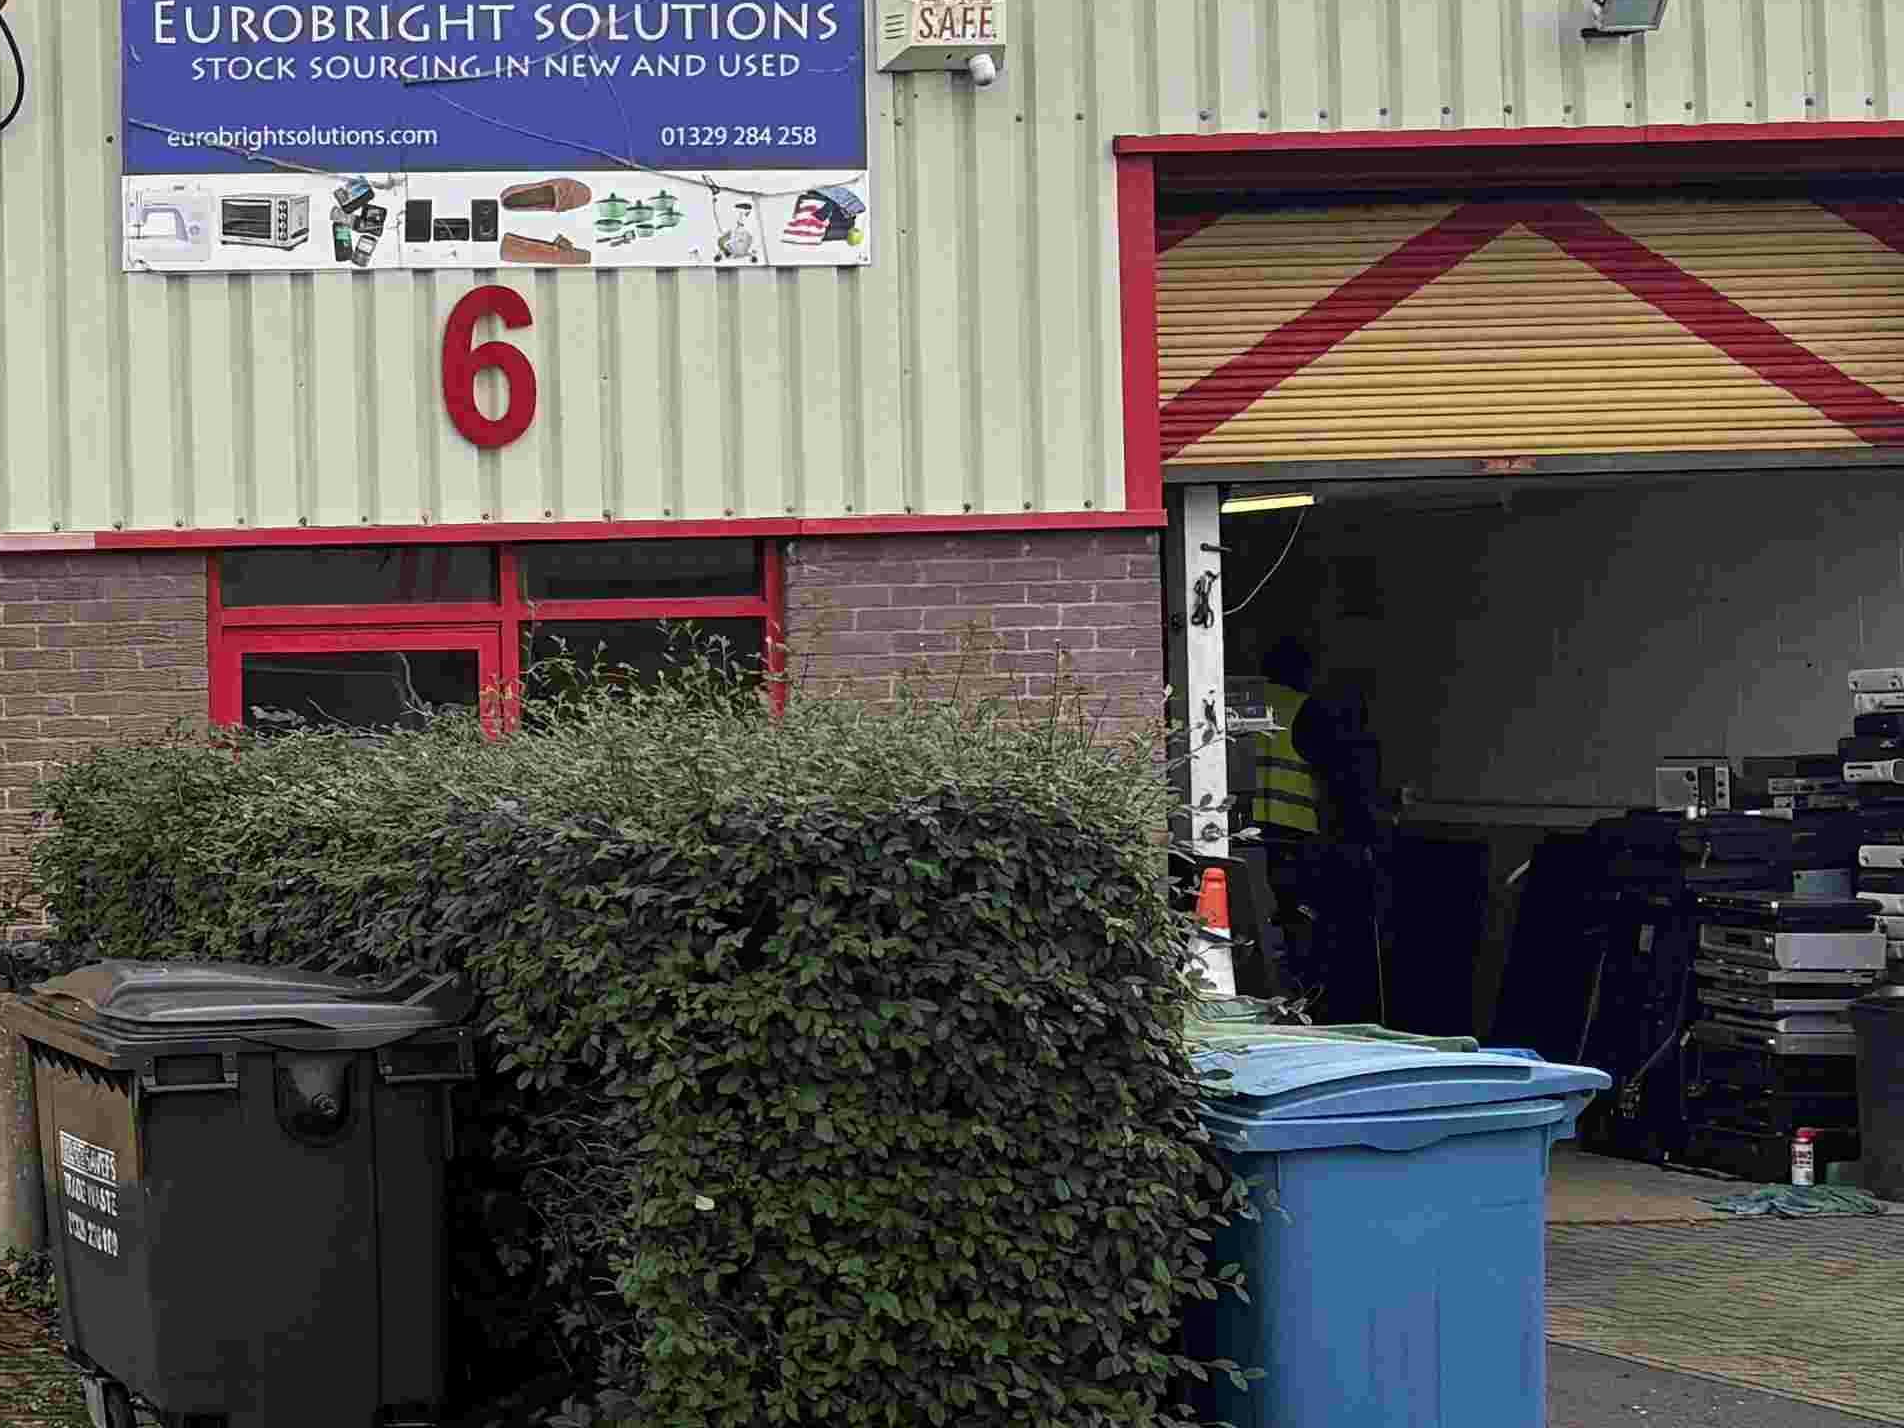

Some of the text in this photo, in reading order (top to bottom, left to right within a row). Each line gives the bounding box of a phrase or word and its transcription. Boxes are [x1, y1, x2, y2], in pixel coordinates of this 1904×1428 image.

[151, 0, 838, 45] EUROBRIGHT SOLUTIONS
[919, 5, 997, 39] S.A.F.E.
[191, 53, 801, 81] STOCK SOURCING IN NEW AND USED
[167, 125, 818, 152] eurobrightsolutions.com 01329 284 258
[443, 284, 537, 449] 6
